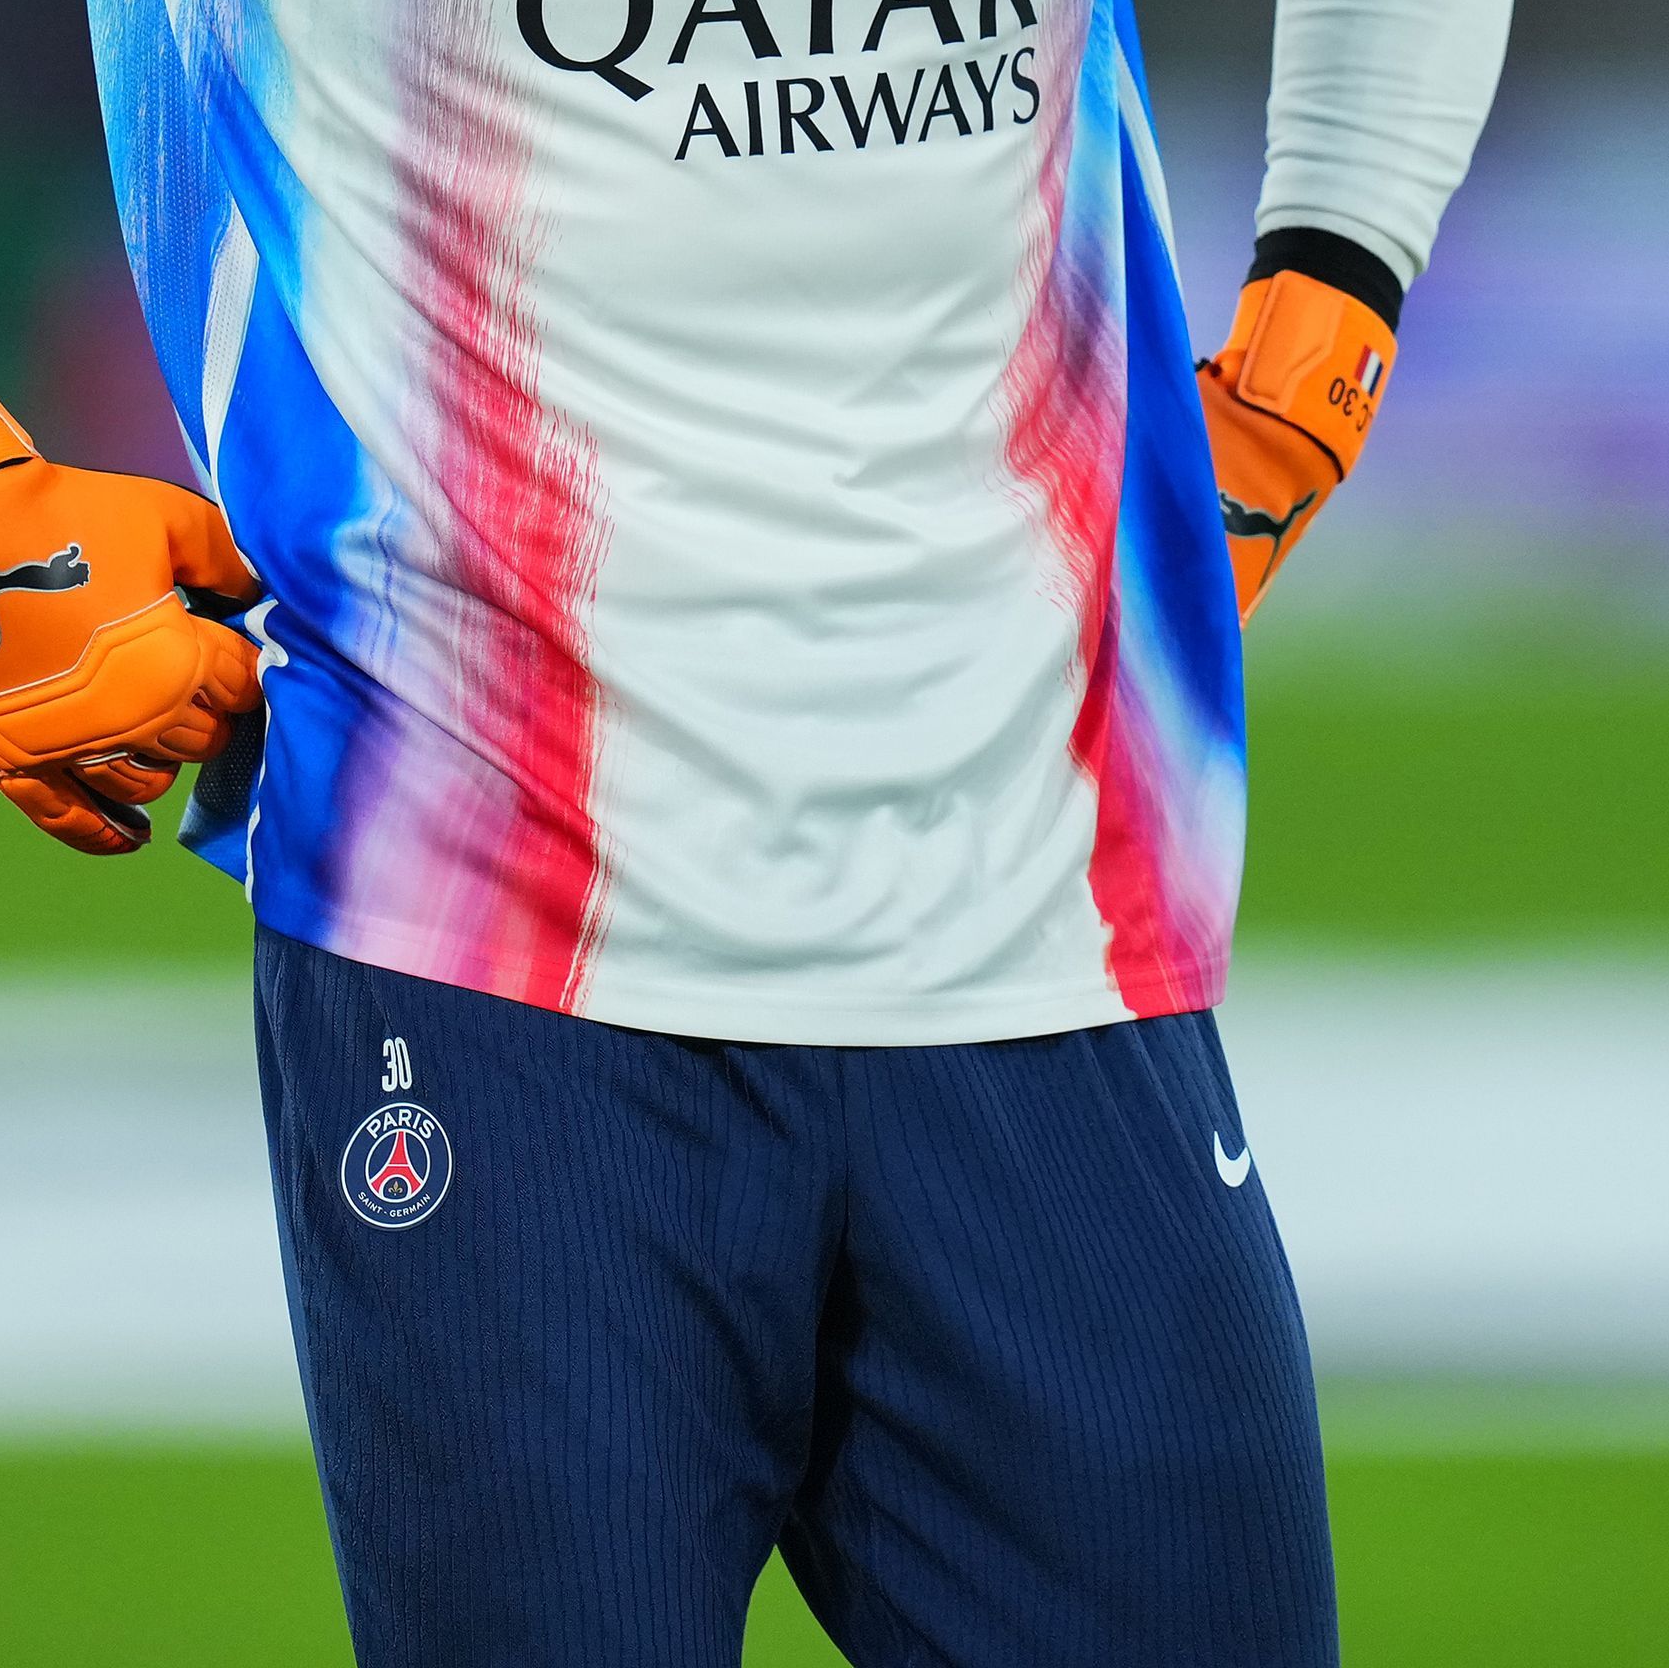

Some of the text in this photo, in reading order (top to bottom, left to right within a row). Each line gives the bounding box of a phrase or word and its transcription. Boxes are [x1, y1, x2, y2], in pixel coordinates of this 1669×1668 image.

[674, 46, 1041, 161] AIRWAYS
[1328, 377, 1374, 432] C 30
[382, 1036, 413, 1092] 30
[365, 1108, 436, 1140] PARIS
